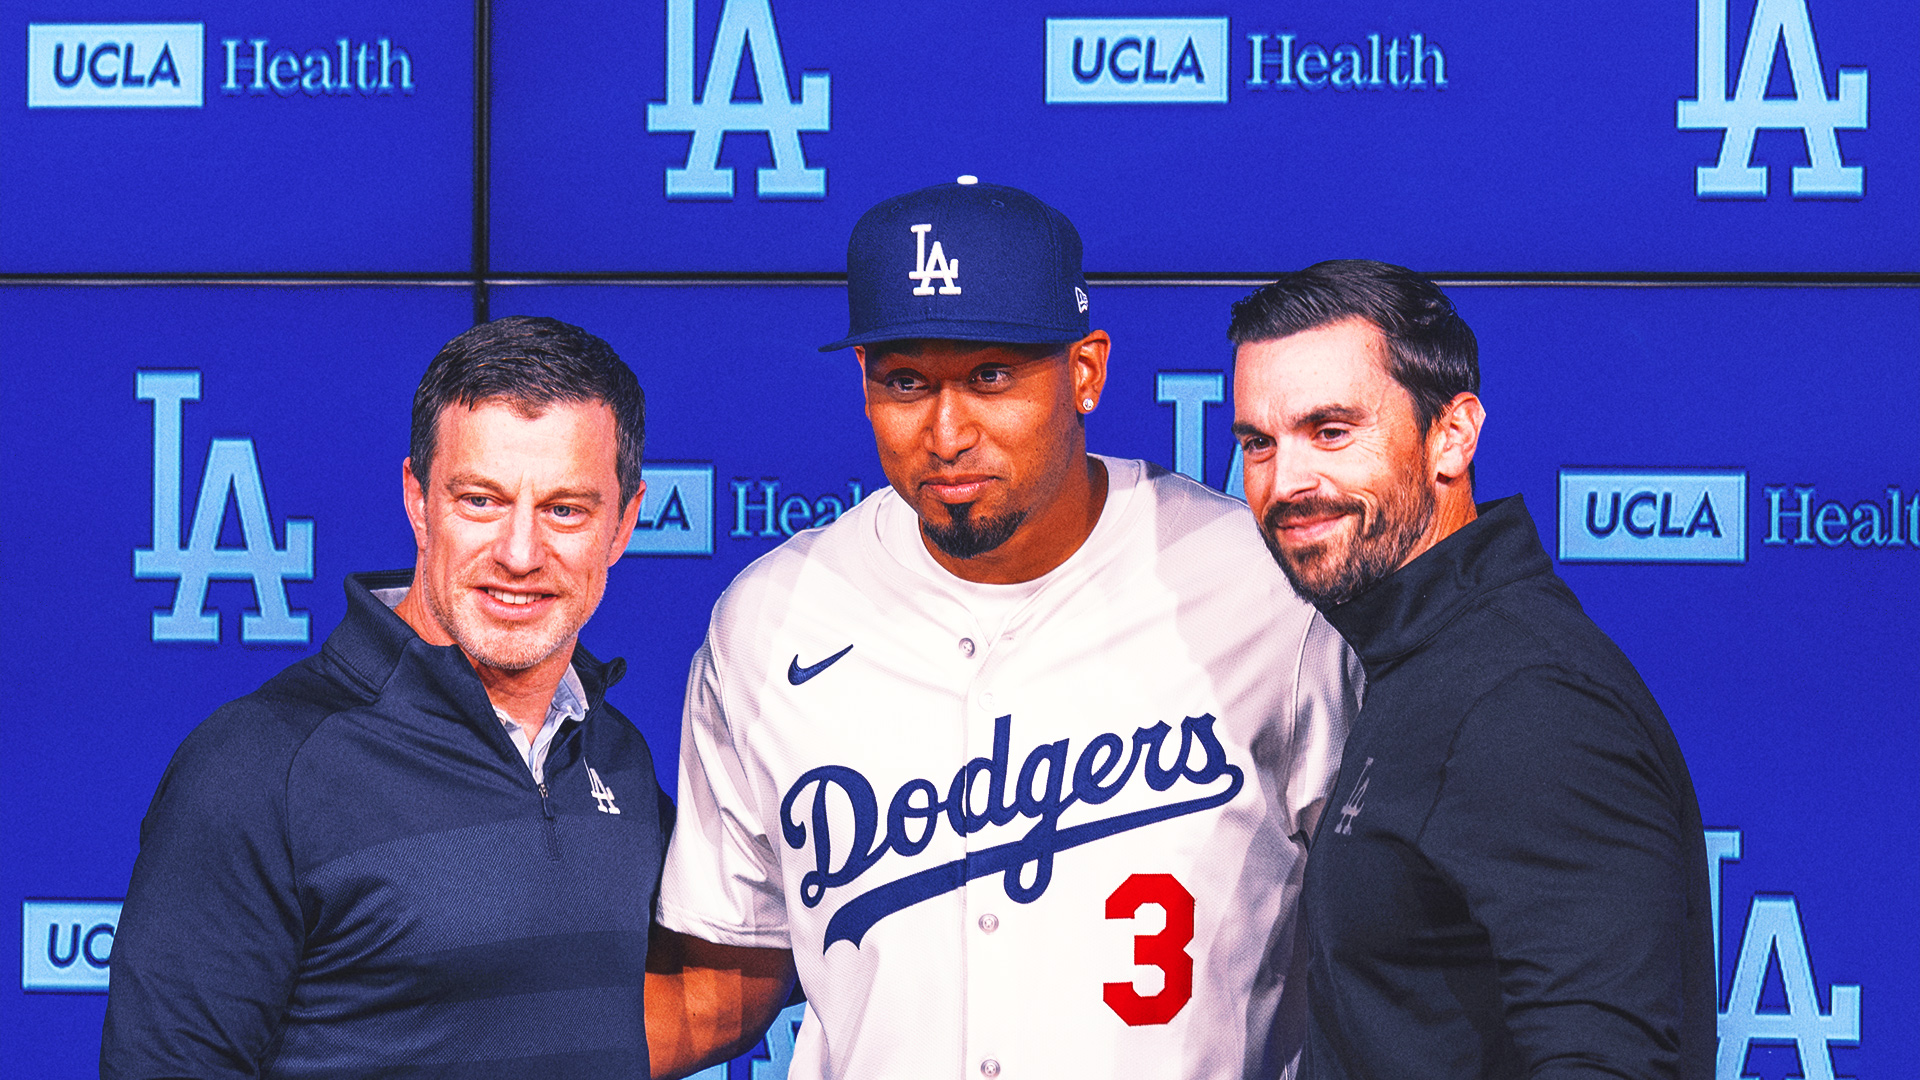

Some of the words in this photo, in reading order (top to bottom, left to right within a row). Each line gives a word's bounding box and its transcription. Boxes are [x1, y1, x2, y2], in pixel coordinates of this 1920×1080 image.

[53, 43, 181, 88] UCLA
[221, 40, 413, 92] Health
[647, 0, 831, 197] LA
[1071, 36, 1205, 84] UCLA
[1246, 33, 1447, 88] Health
[1677, 0, 1868, 196] LA
[909, 223, 962, 296] LA
[134, 370, 314, 642] LA
[1585, 491, 1722, 538] UCLA
[1763, 487, 1920, 545] Healt
[583, 756, 621, 815] LA
[780, 712, 1245, 908] Dodgers
[1334, 756, 1374, 836] LA
[1102, 872, 1196, 1027] 3
